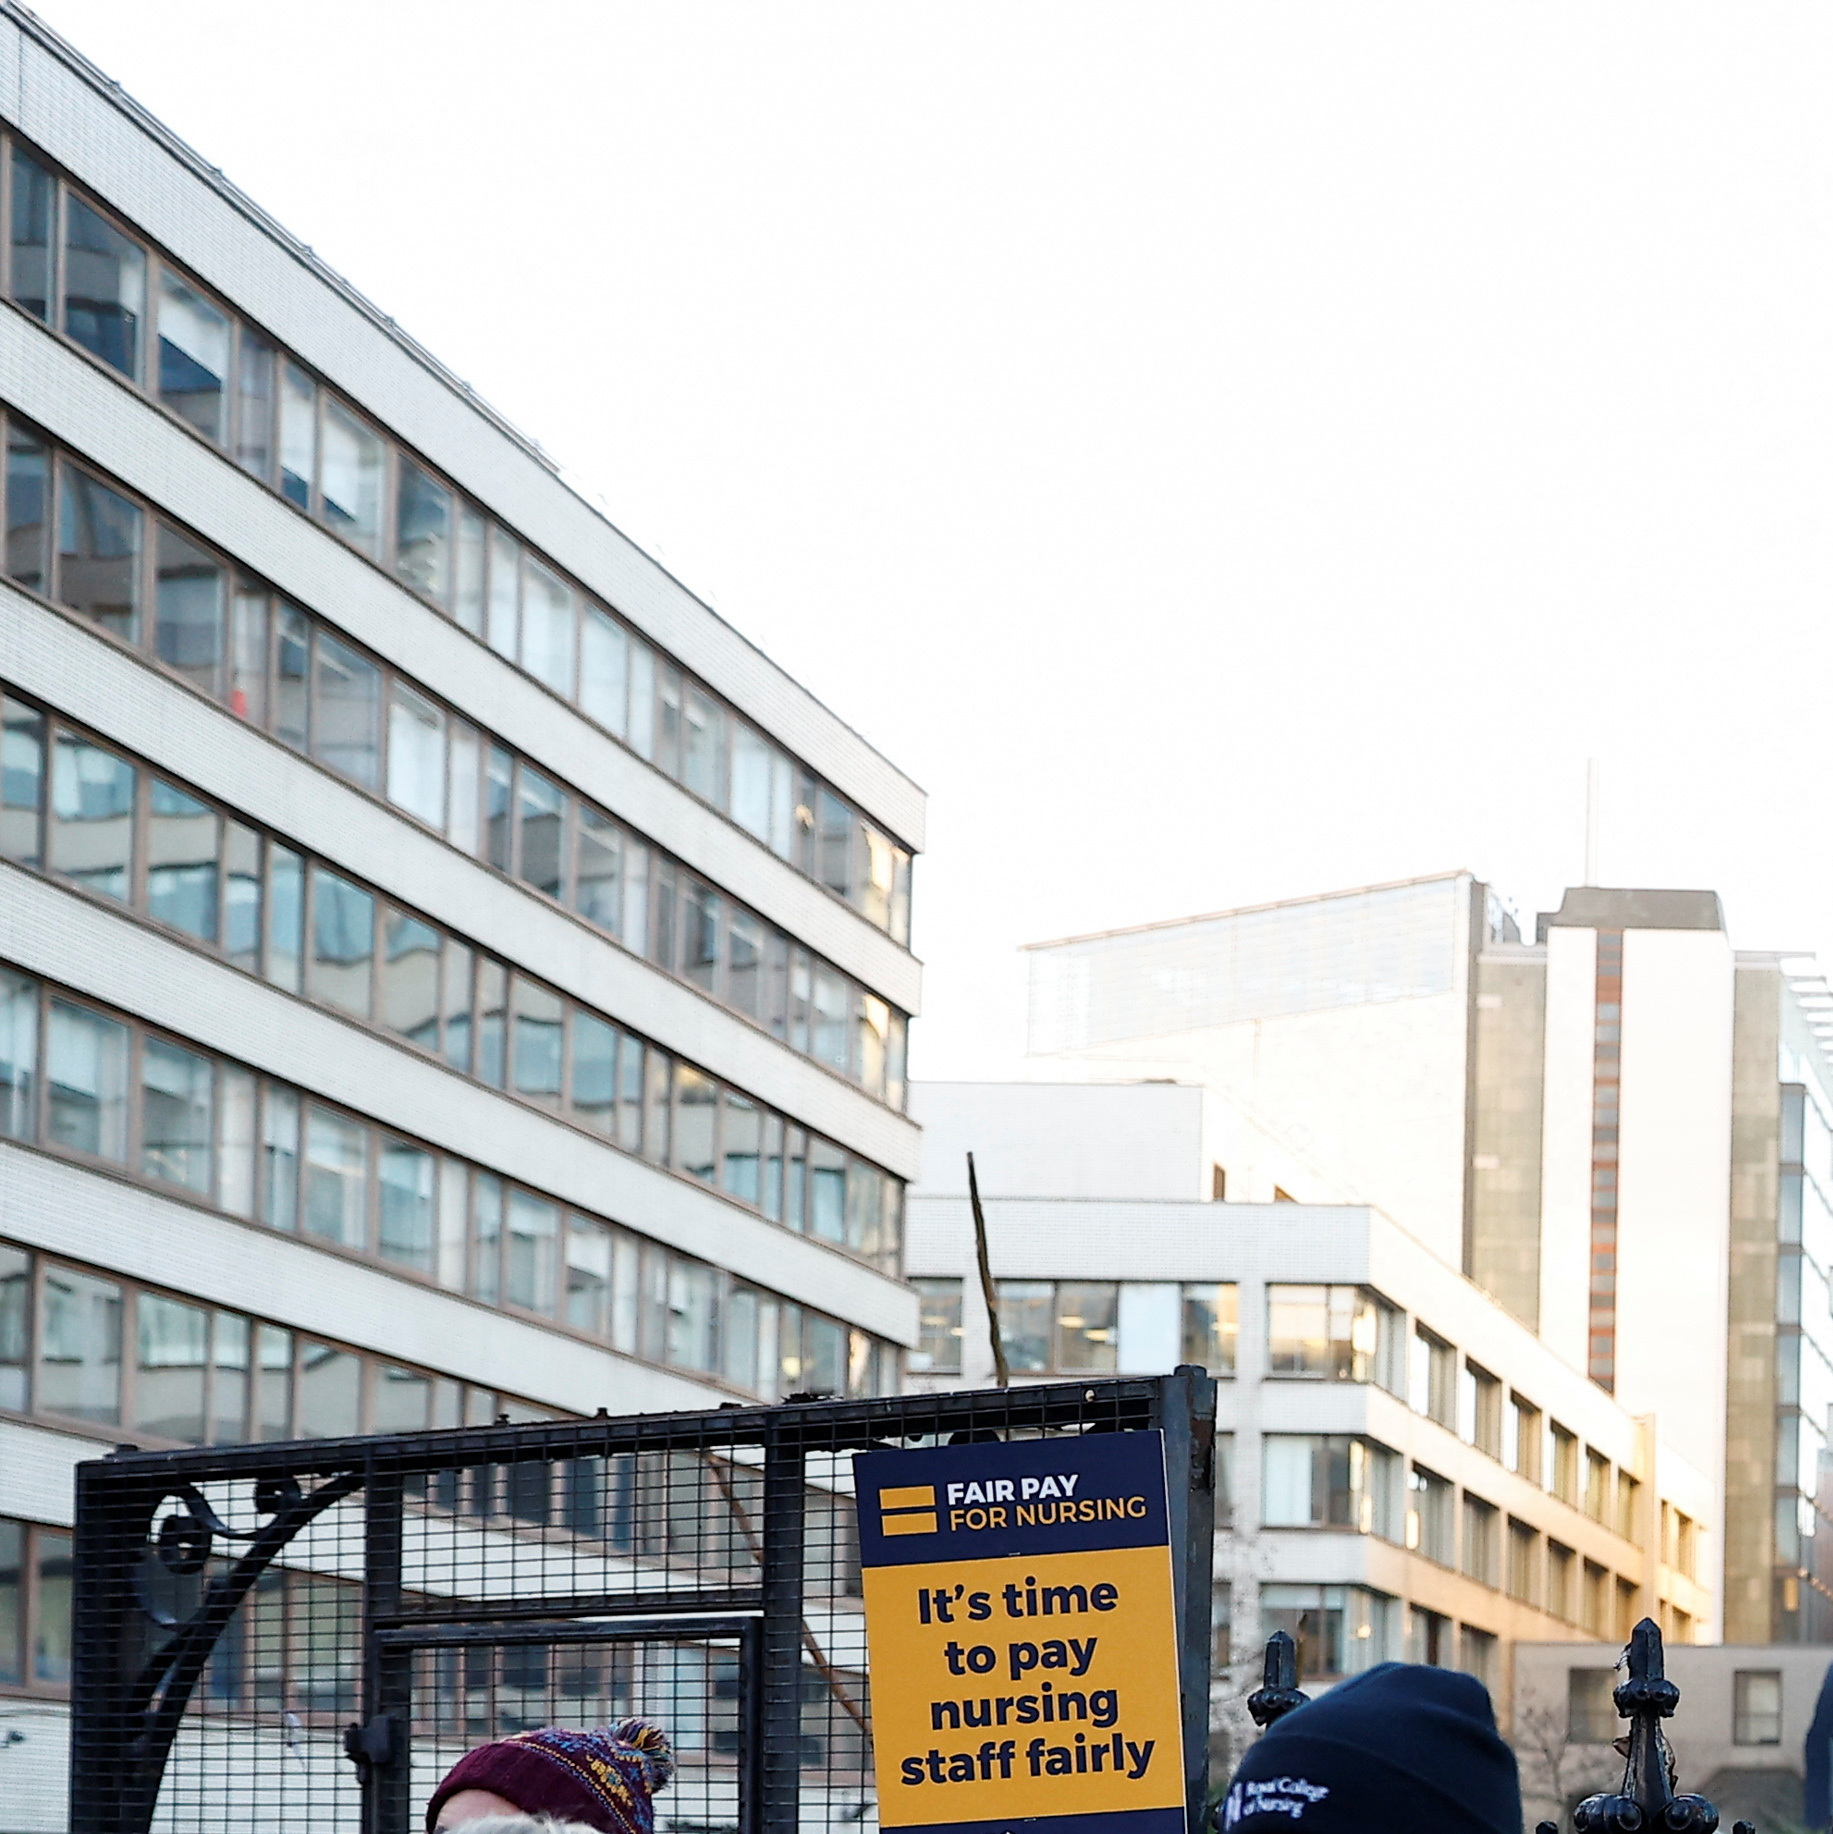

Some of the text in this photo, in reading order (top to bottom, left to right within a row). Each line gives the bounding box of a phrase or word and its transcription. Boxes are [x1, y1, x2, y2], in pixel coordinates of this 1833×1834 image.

[947, 1474, 1079, 1505] FAIR PAY
[950, 1496, 1147, 1531] FOR NURSING
[1002, 1576, 1118, 1618] time
[945, 1637, 1097, 1681] to pay
[930, 1682, 1118, 1730] nursing
[901, 1733, 1155, 1786] staff fairly
